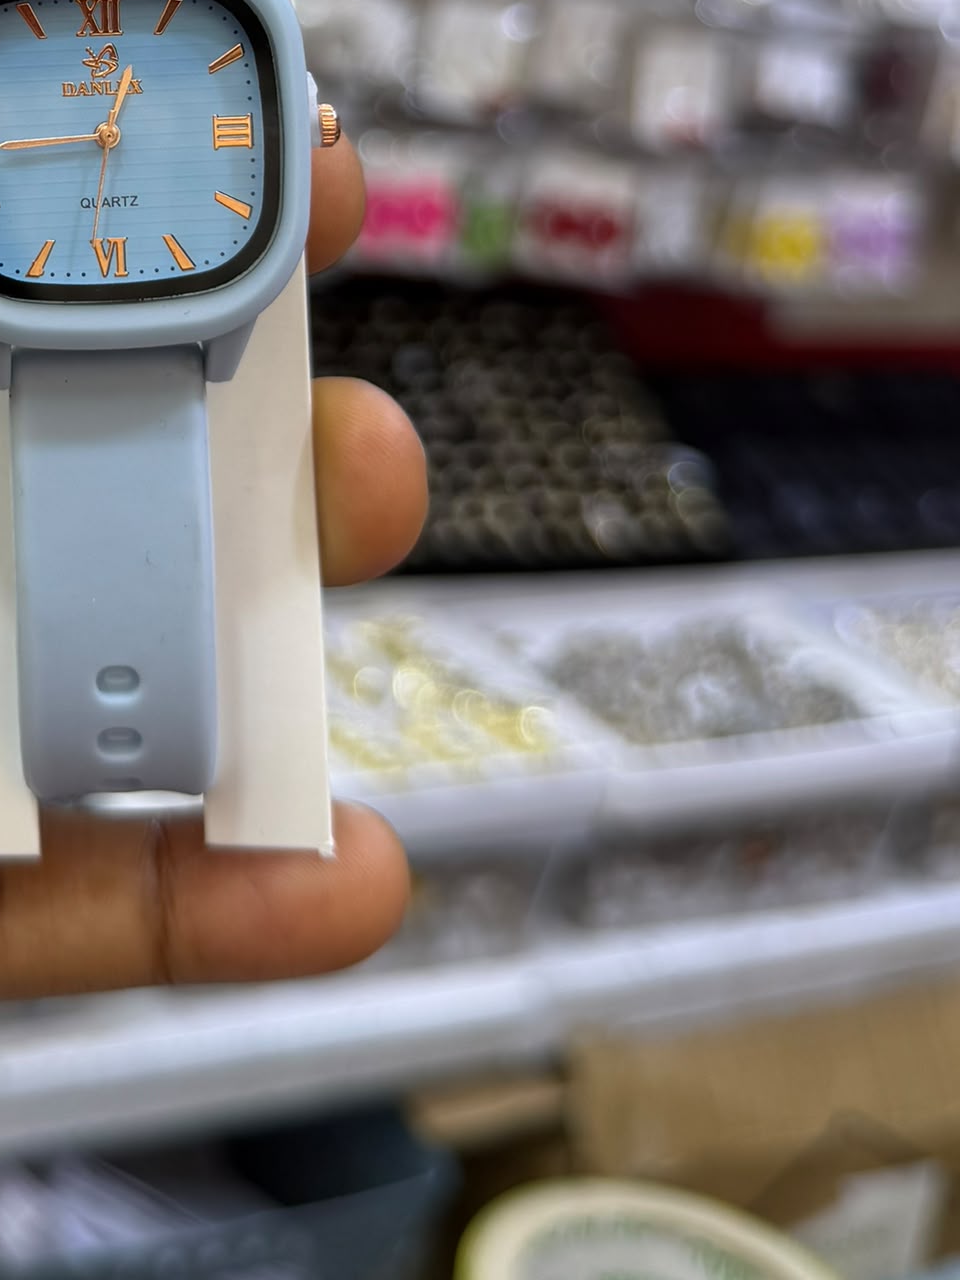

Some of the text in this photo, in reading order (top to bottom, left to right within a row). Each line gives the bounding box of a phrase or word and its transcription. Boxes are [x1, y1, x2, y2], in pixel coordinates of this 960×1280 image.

[61, 79, 144, 97] DANLX
[80, 195, 139, 209] QUARTZ
[90, 237, 129, 278] VI
